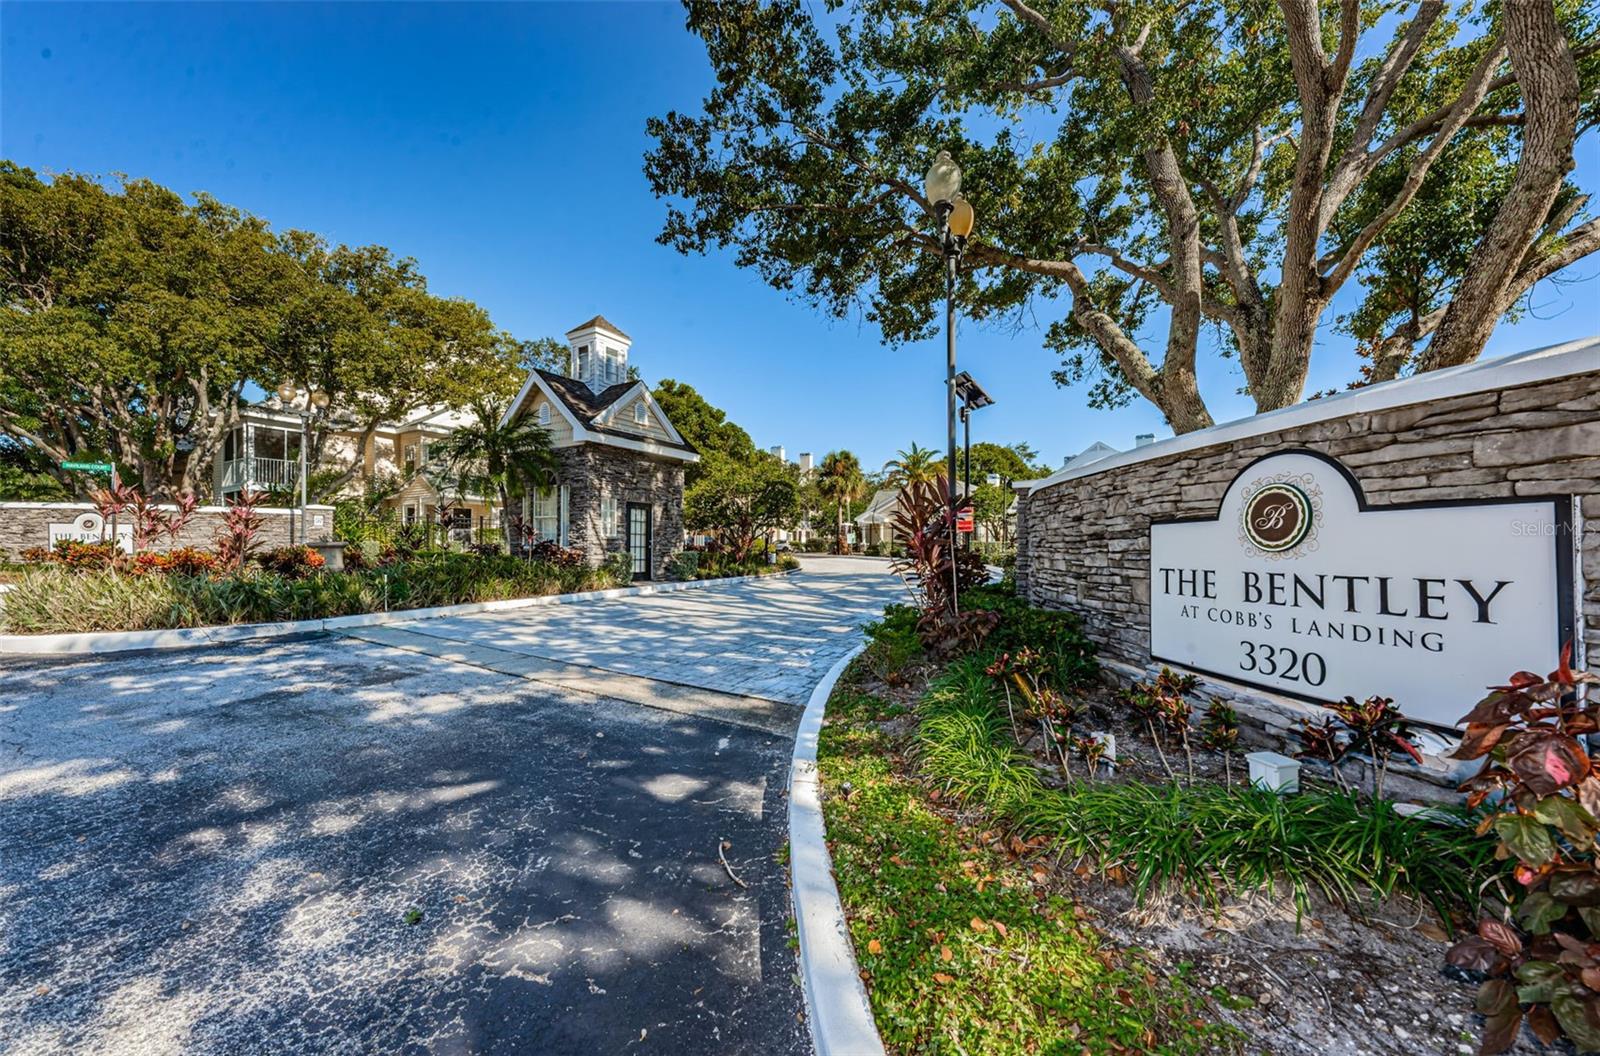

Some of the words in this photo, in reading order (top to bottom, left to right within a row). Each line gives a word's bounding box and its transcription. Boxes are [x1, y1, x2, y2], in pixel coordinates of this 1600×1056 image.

[80, 533, 128, 541] BENLY
[1255, 502, 1294, 530] B
[1159, 568, 1217, 599] THE
[1242, 571, 1514, 624] BENTLEY
[1181, 605, 1200, 619] AT
[1207, 608, 1272, 630] COBB'S
[1292, 618, 1443, 652] LANDING
[1240, 641, 1326, 686] 3320
